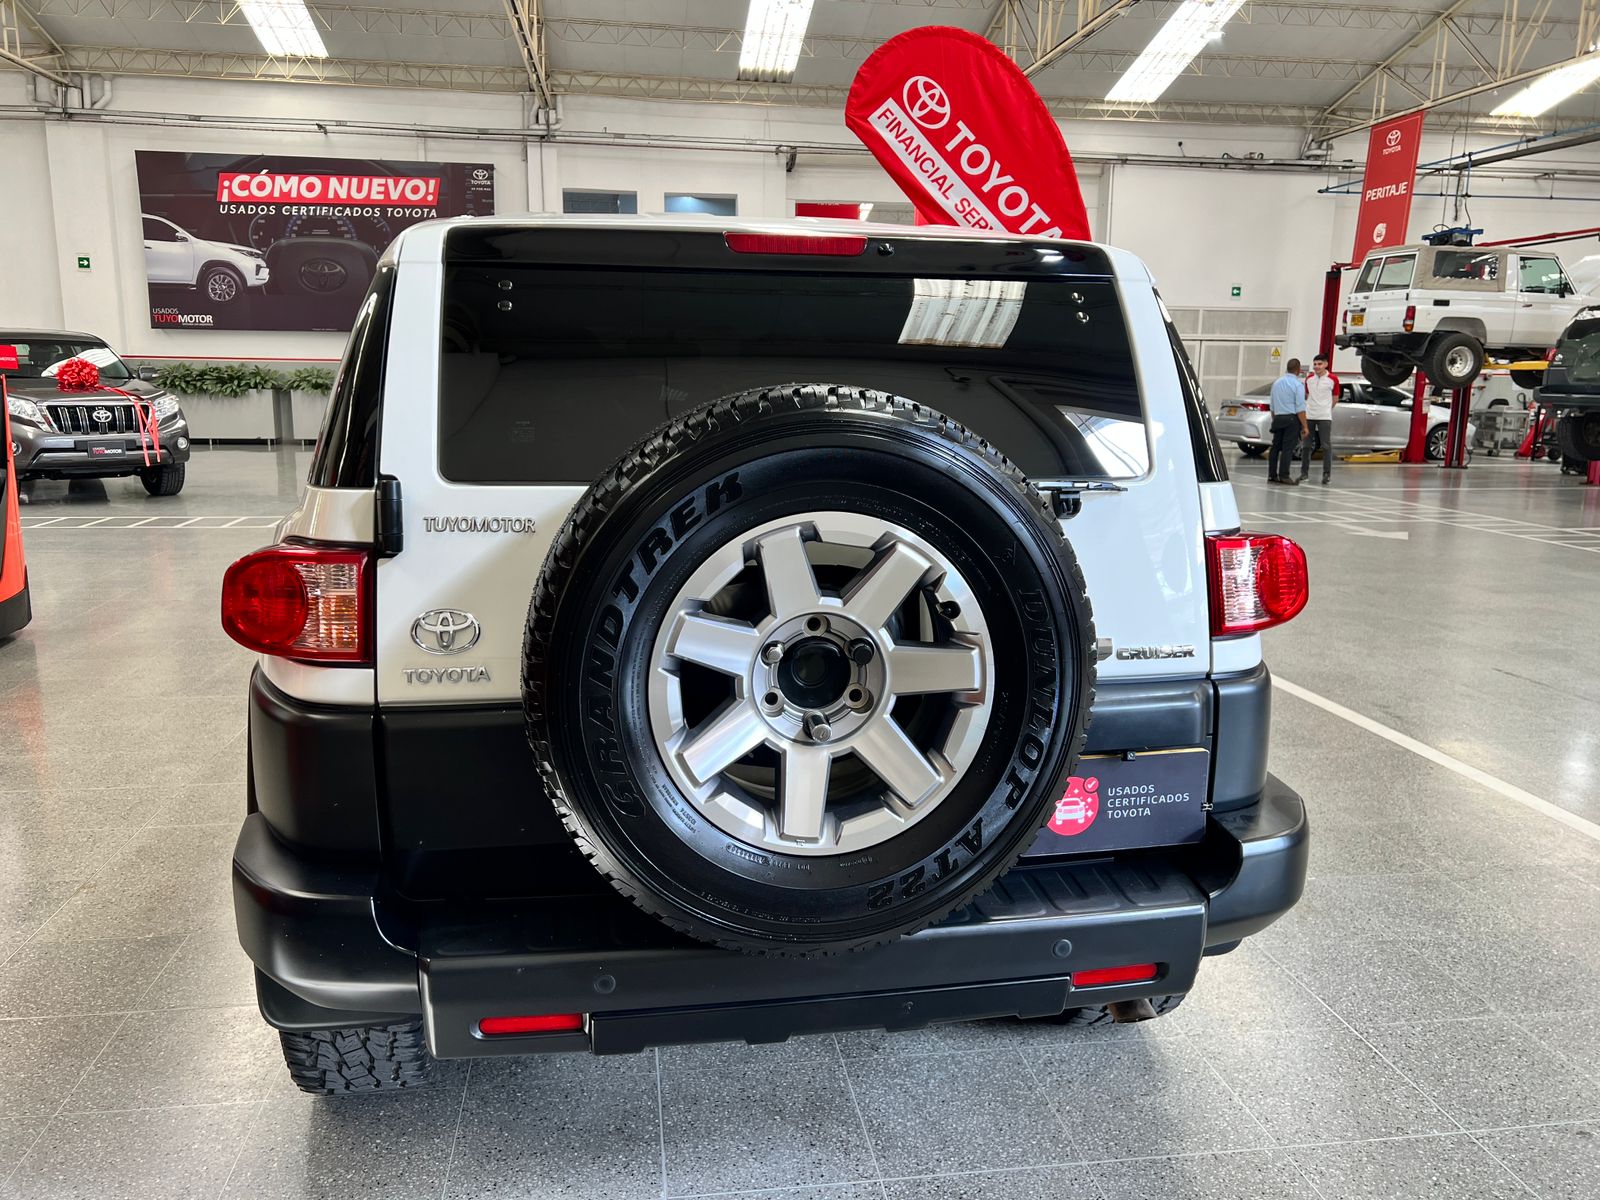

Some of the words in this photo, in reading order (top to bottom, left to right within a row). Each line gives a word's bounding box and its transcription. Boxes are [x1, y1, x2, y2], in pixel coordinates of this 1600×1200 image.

[1382, 145, 1401, 155] TOYOTA
[877, 107, 955, 200] FINANCIAL
[954, 197, 994, 230] SER
[221, 169, 323, 202] ¡CÓMO
[327, 177, 436, 202] NUEVO!
[1365, 181, 1408, 202] PERITAJE
[219, 204, 276, 215] USADOS
[282, 205, 381, 217] CERTIFICADOS
[387, 208, 438, 218] TOYOTA
[153, 314, 213, 324] TUYOMOTOR
[423, 516, 536, 533] TUYOMOTOR
[586, 472, 743, 818] GRANDTREK
[1116, 644, 1196, 660] CRUISER
[402, 666, 491, 684] TOYOTA
[1005, 587, 1057, 810] DUNLOP
[1108, 784, 1155, 797] USADOS
[1107, 793, 1190, 808] CERTIFICADOS
[1107, 807, 1151, 819] TOYOTA
[867, 818, 984, 911] AT22
